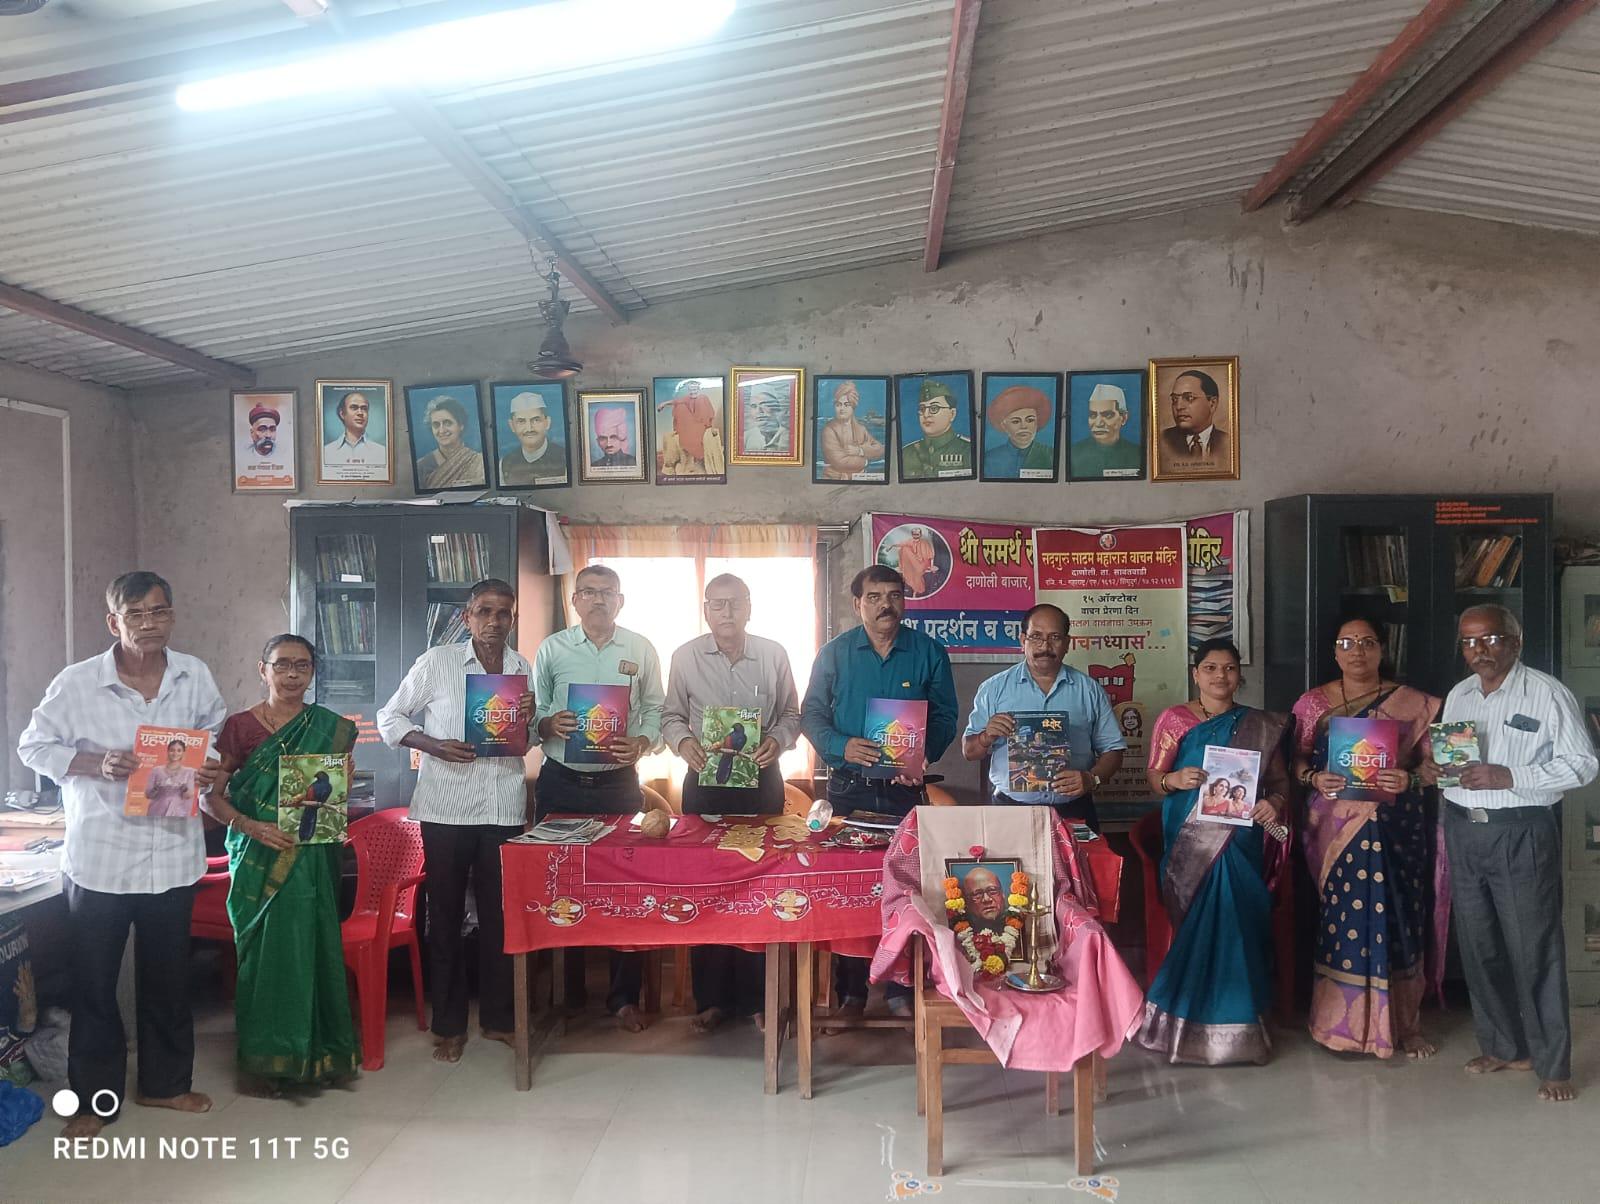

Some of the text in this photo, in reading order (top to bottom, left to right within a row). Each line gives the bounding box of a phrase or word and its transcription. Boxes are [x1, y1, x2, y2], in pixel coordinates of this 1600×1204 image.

[959, 526, 979, 567] श्री
[982, 529, 1022, 567] समर्थ
[1071, 552, 1095, 565] साटम
[1095, 551, 1128, 567] महाराज
[1129, 551, 1153, 564] वाचन
[1155, 546, 1177, 567] मंदिर
[966, 572, 1031, 591] दाणोली बाजार,
[1082, 592, 1137, 604] १५ ऑक्टोबर
[1081, 604, 1139, 615] वाचन प्रेरणा दिन
[983, 620, 999, 641] व
[473, 705, 519, 724] आरती
[575, 714, 618, 732] आरती
[872, 730, 917, 748] आरती
[1337, 750, 1388, 769] आरती
